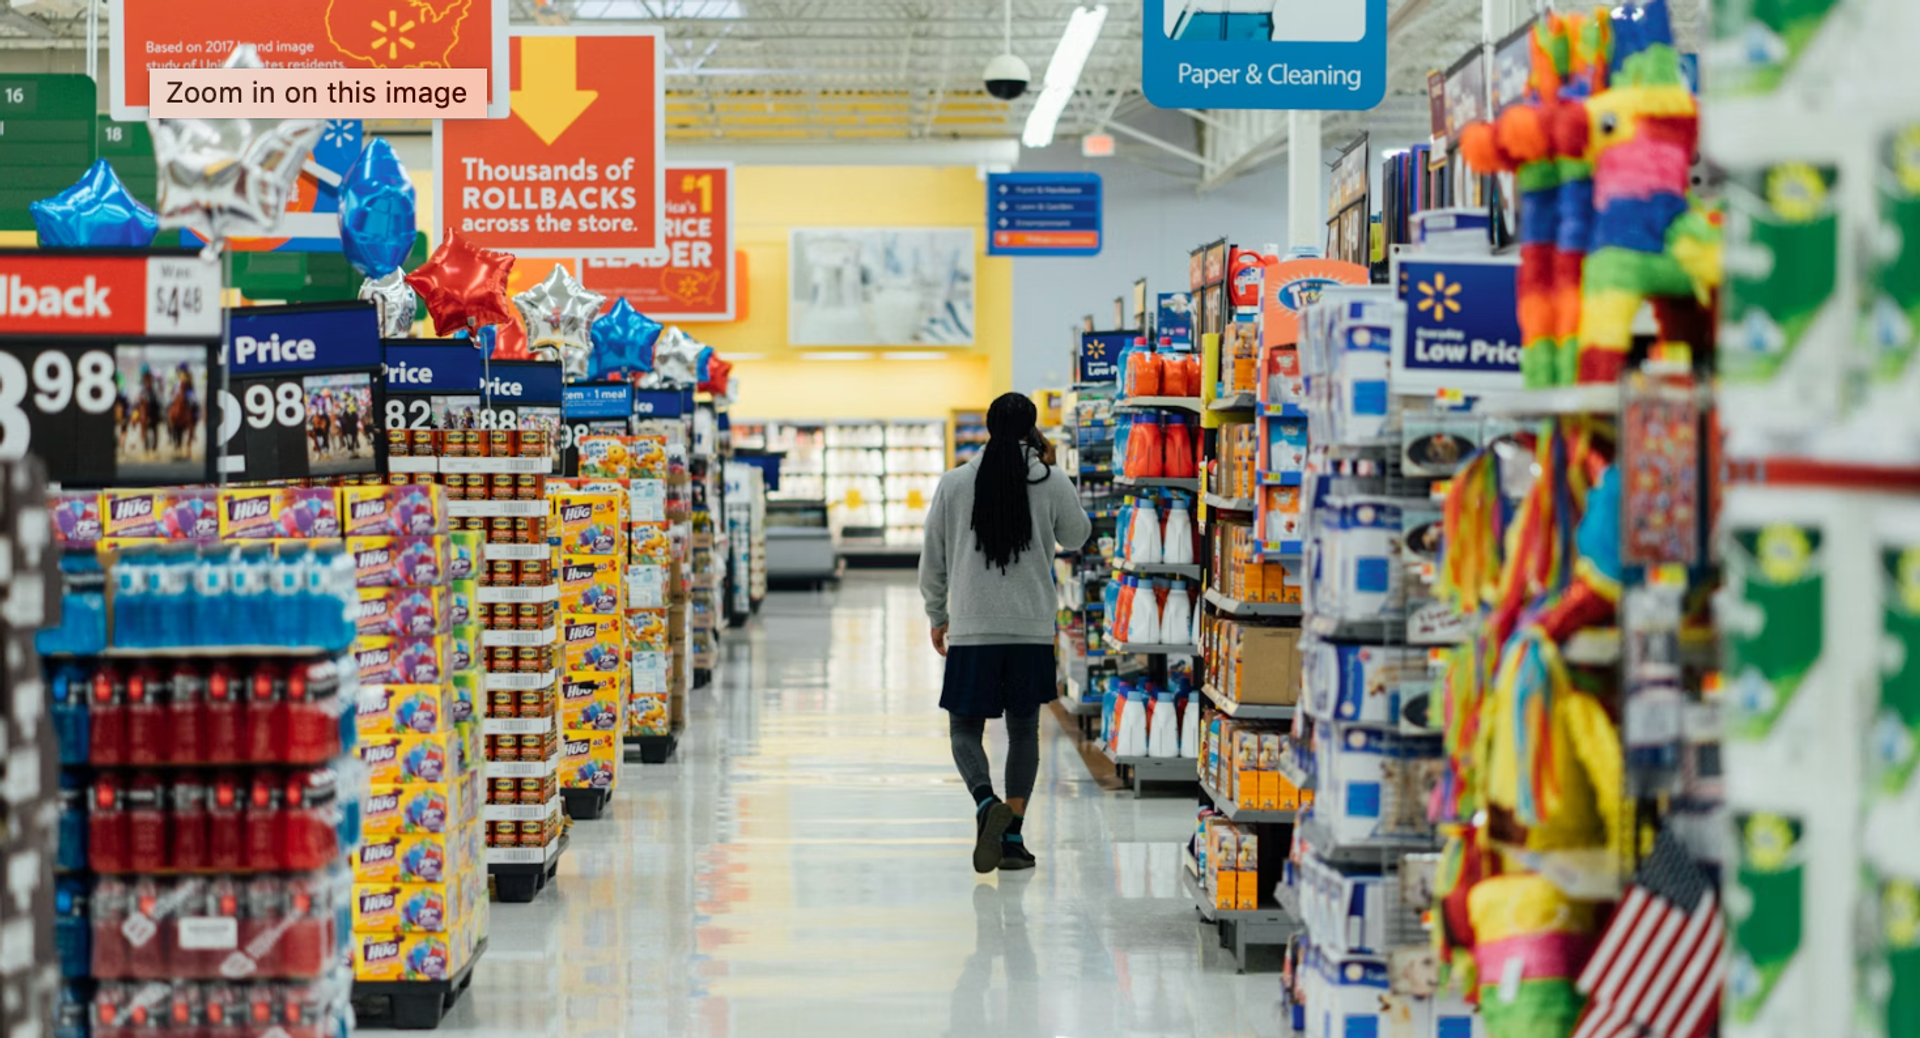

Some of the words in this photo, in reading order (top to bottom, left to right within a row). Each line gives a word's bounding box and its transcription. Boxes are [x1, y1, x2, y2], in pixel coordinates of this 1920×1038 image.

[147, 41, 182, 54] Based
[186, 44, 203, 54] on
[205, 41, 234, 53] 2017
[276, 41, 315, 56] image
[1178, 62, 1241, 89] Paper
[1245, 63, 1263, 85] &
[1267, 63, 1362, 91] Cleaning
[5, 87, 24, 104] 16
[105, 126, 122, 142] 18
[461, 157, 599, 182] Thousands
[605, 157, 635, 182] of
[462, 186, 637, 210] ROLLBACKS
[681, 173, 713, 214] #1
[461, 218, 530, 233] across
[535, 213, 573, 233] the
[577, 215, 639, 233] store.
[235, 332, 316, 365] Price
[1415, 339, 1468, 363] Low
[1087, 366, 1109, 377] Low
[601, 388, 628, 400] meal
[384, 398, 432, 431] 82
[116, 499, 151, 520] HUG
[233, 498, 271, 521] HUG
[355, 500, 386, 518] HUG
[564, 506, 591, 521] HUG
[360, 550, 389, 568] HUG
[569, 624, 595, 640] HUG
[360, 650, 389, 668] HUG
[366, 746, 395, 763] HUG
[563, 742, 589, 756] HUG
[367, 795, 397, 814] HUG
[364, 845, 394, 863] HUG
[364, 895, 394, 912] HUG
[367, 943, 398, 961] HUG
